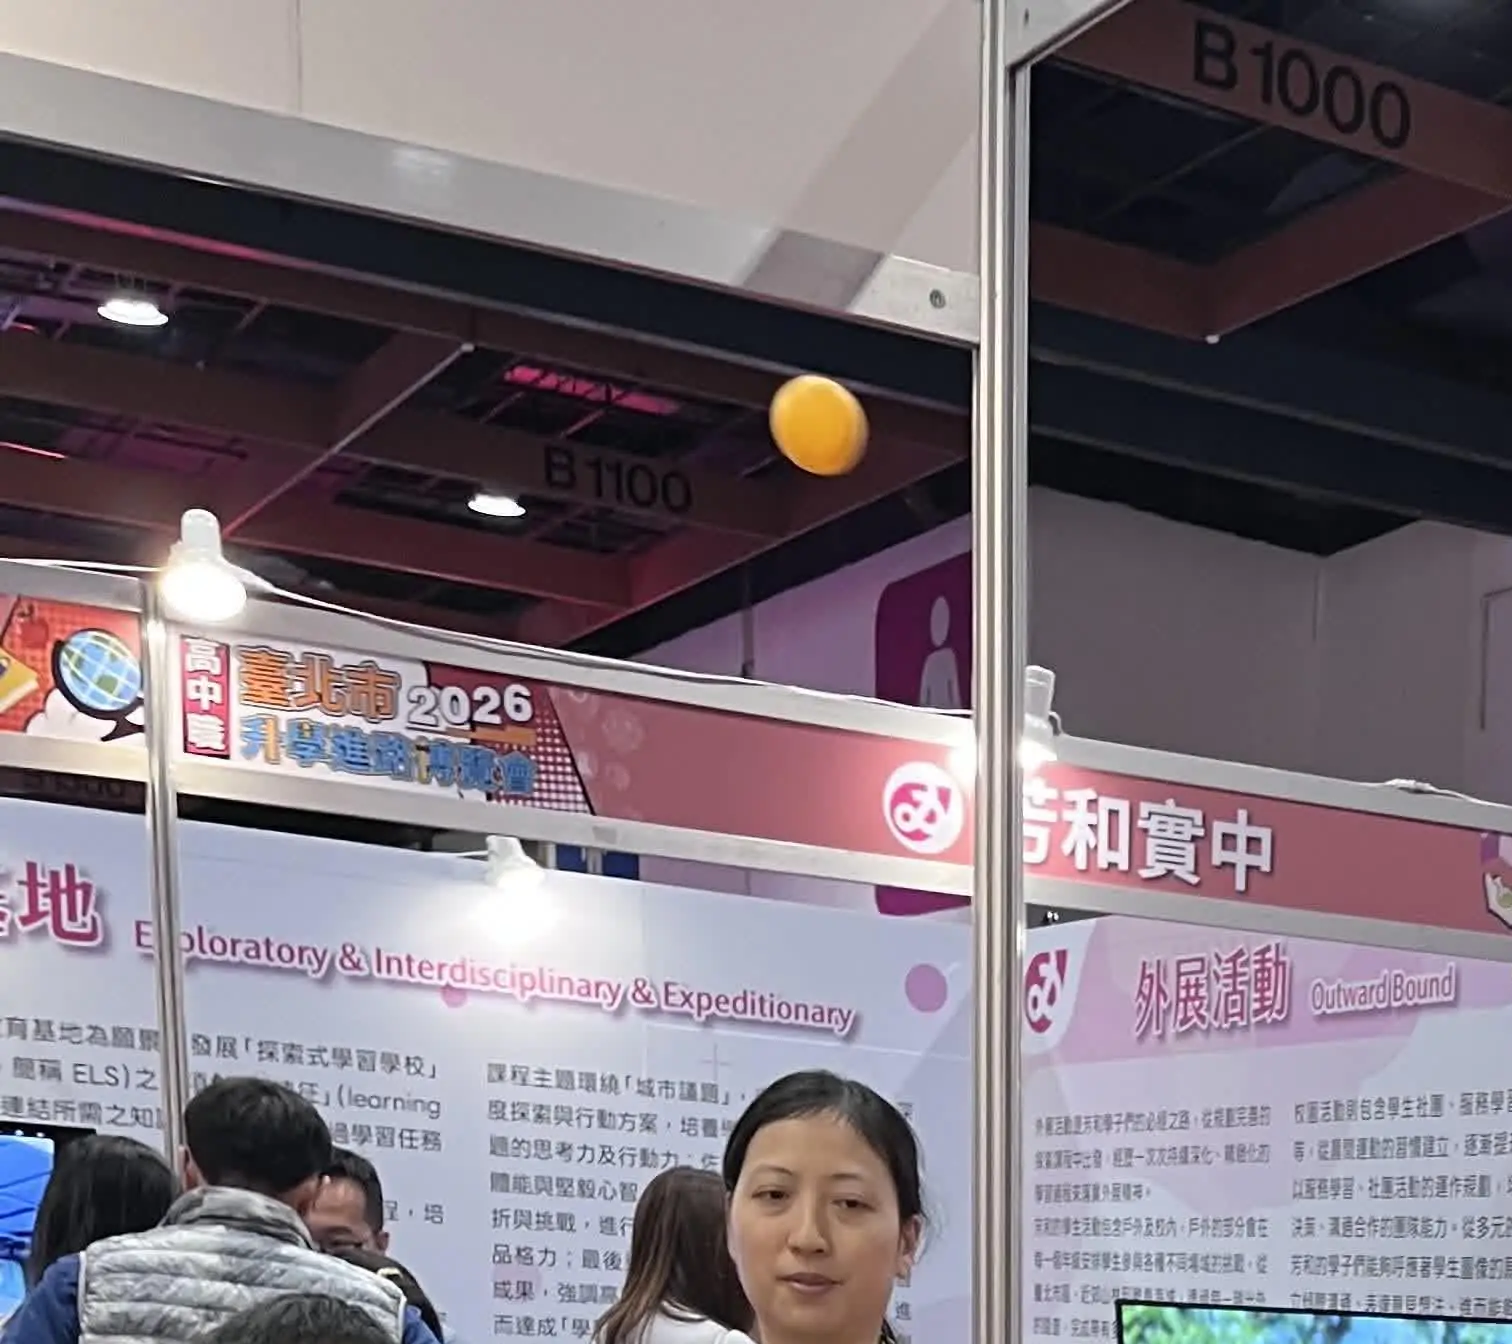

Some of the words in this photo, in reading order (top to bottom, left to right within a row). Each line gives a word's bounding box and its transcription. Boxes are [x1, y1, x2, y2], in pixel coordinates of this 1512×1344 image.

[1192, 18, 1411, 152] B1000
[238, 647, 401, 723] 臺北市
[407, 684, 534, 726] 2026
[0, 861, 101, 943] 地
[135, 919, 328, 974] Eploratory
[375, 948, 623, 1009] Interdisciplinary
[664, 980, 854, 1034] Expeditionary
[1134, 942, 1289, 1040] 外展活動
[1311, 975, 1388, 1016] Outward
[1391, 964, 1455, 1006] Bound
[491, 1244, 631, 1271] 品格力；最後
